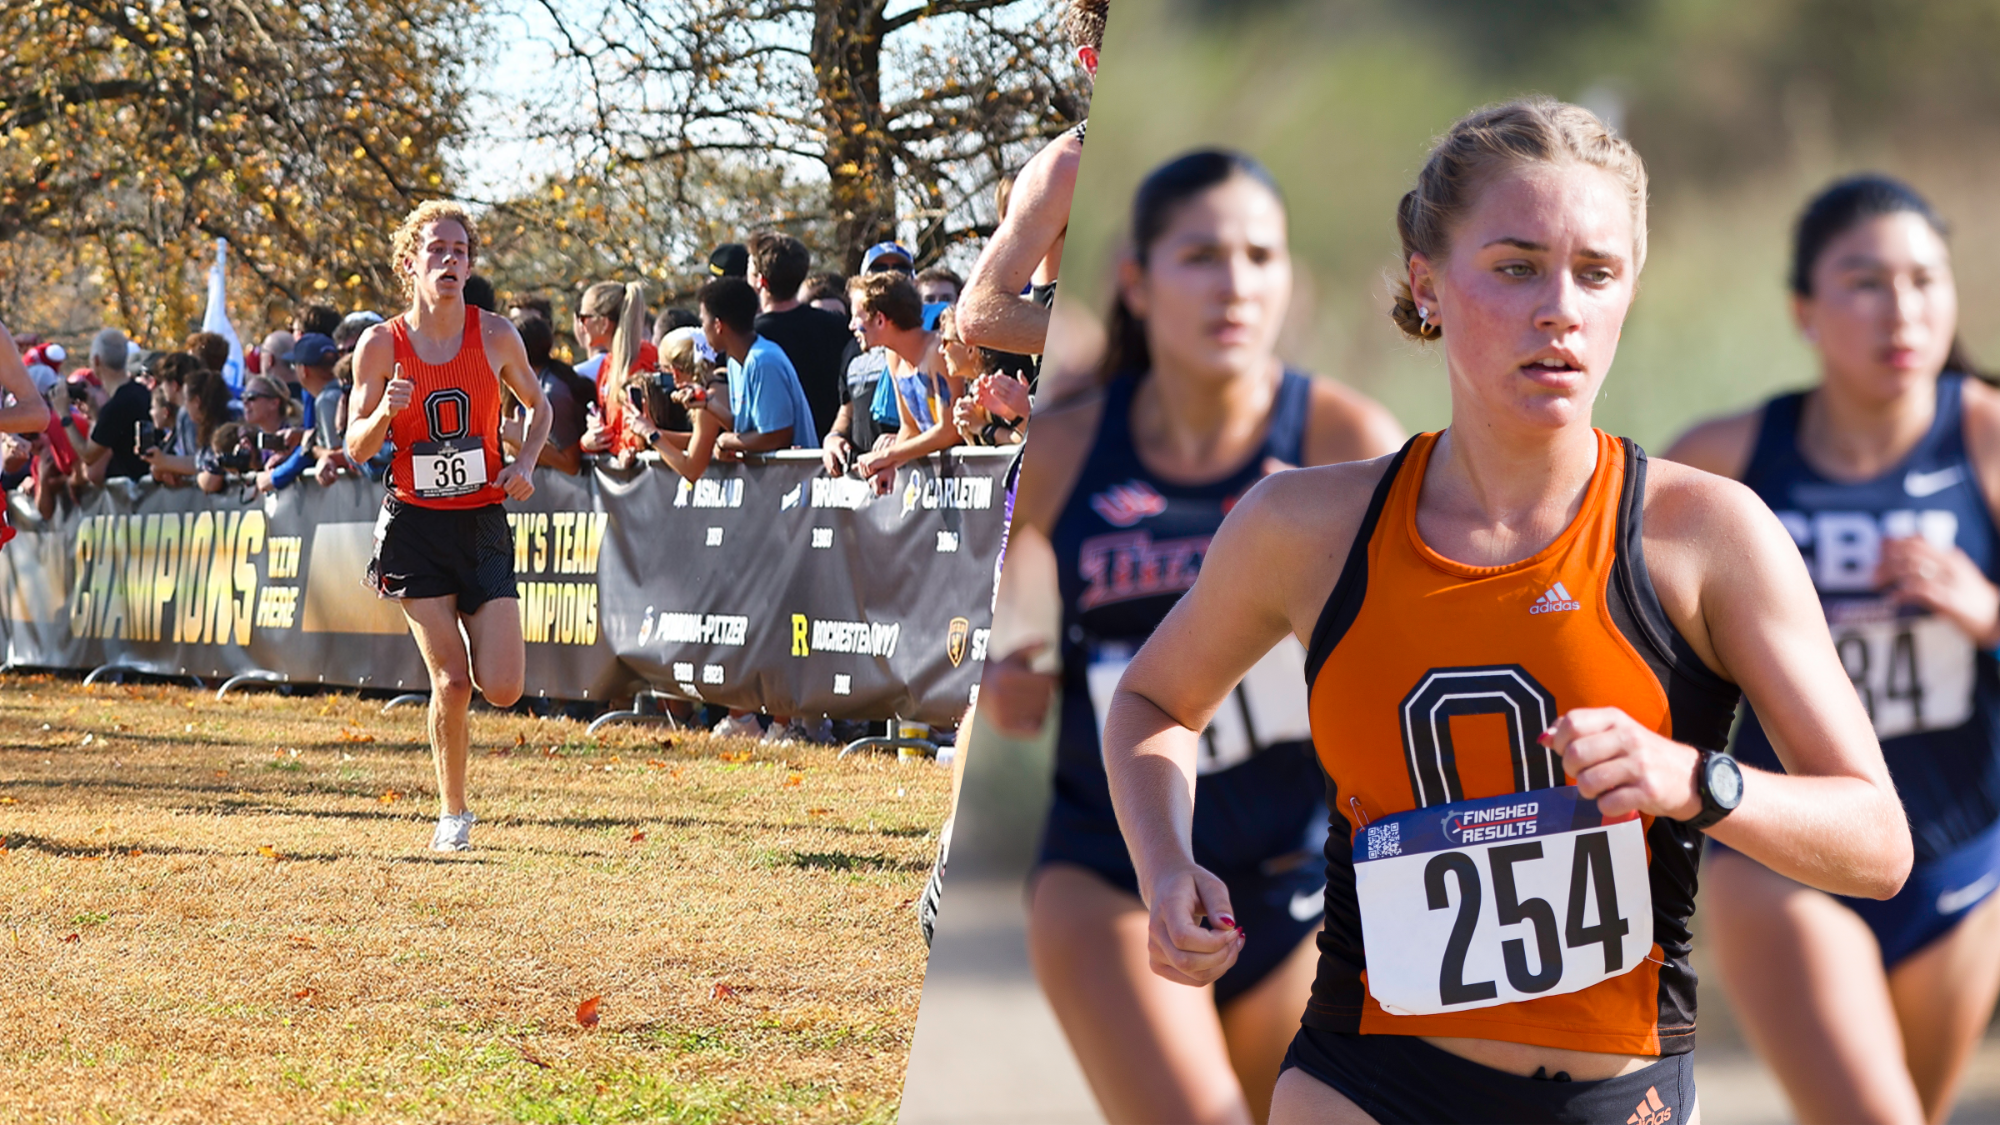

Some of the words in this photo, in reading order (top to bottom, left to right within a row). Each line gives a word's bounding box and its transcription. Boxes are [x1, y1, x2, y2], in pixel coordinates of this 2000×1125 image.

[423, 387, 471, 442] O
[433, 458, 467, 488] 36
[921, 477, 993, 510] CARLETON
[552, 511, 609, 575] TEAM
[70, 509, 266, 646] CHAMPIONS
[256, 586, 299, 629] HERE
[1529, 600, 1581, 615] adidas
[791, 613, 810, 657] R
[1462, 820, 1538, 844] RESULTS
[1463, 801, 1539, 826] FINISHED
[1424, 831, 1629, 1006] 254
